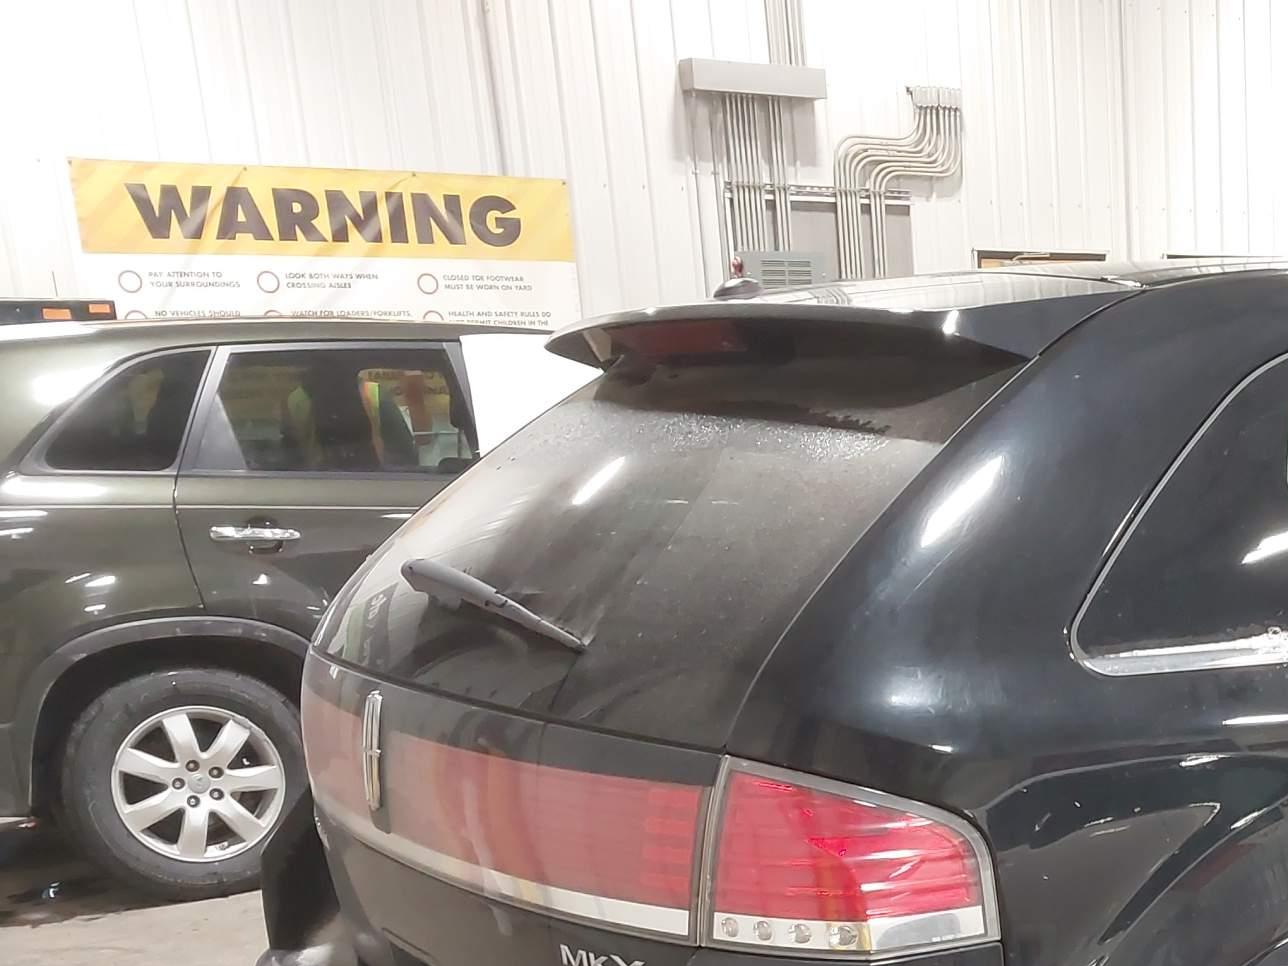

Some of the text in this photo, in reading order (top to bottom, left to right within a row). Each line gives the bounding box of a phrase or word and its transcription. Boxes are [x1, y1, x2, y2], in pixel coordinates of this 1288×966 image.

[124, 183, 521, 248] WARNING
[212, 271, 223, 279] TO
[285, 272, 306, 280] LOOK
[308, 272, 330, 280] BOTH
[286, 281, 352, 289] CROSSING AISLES
[208, 310, 241, 318] SHOULD
